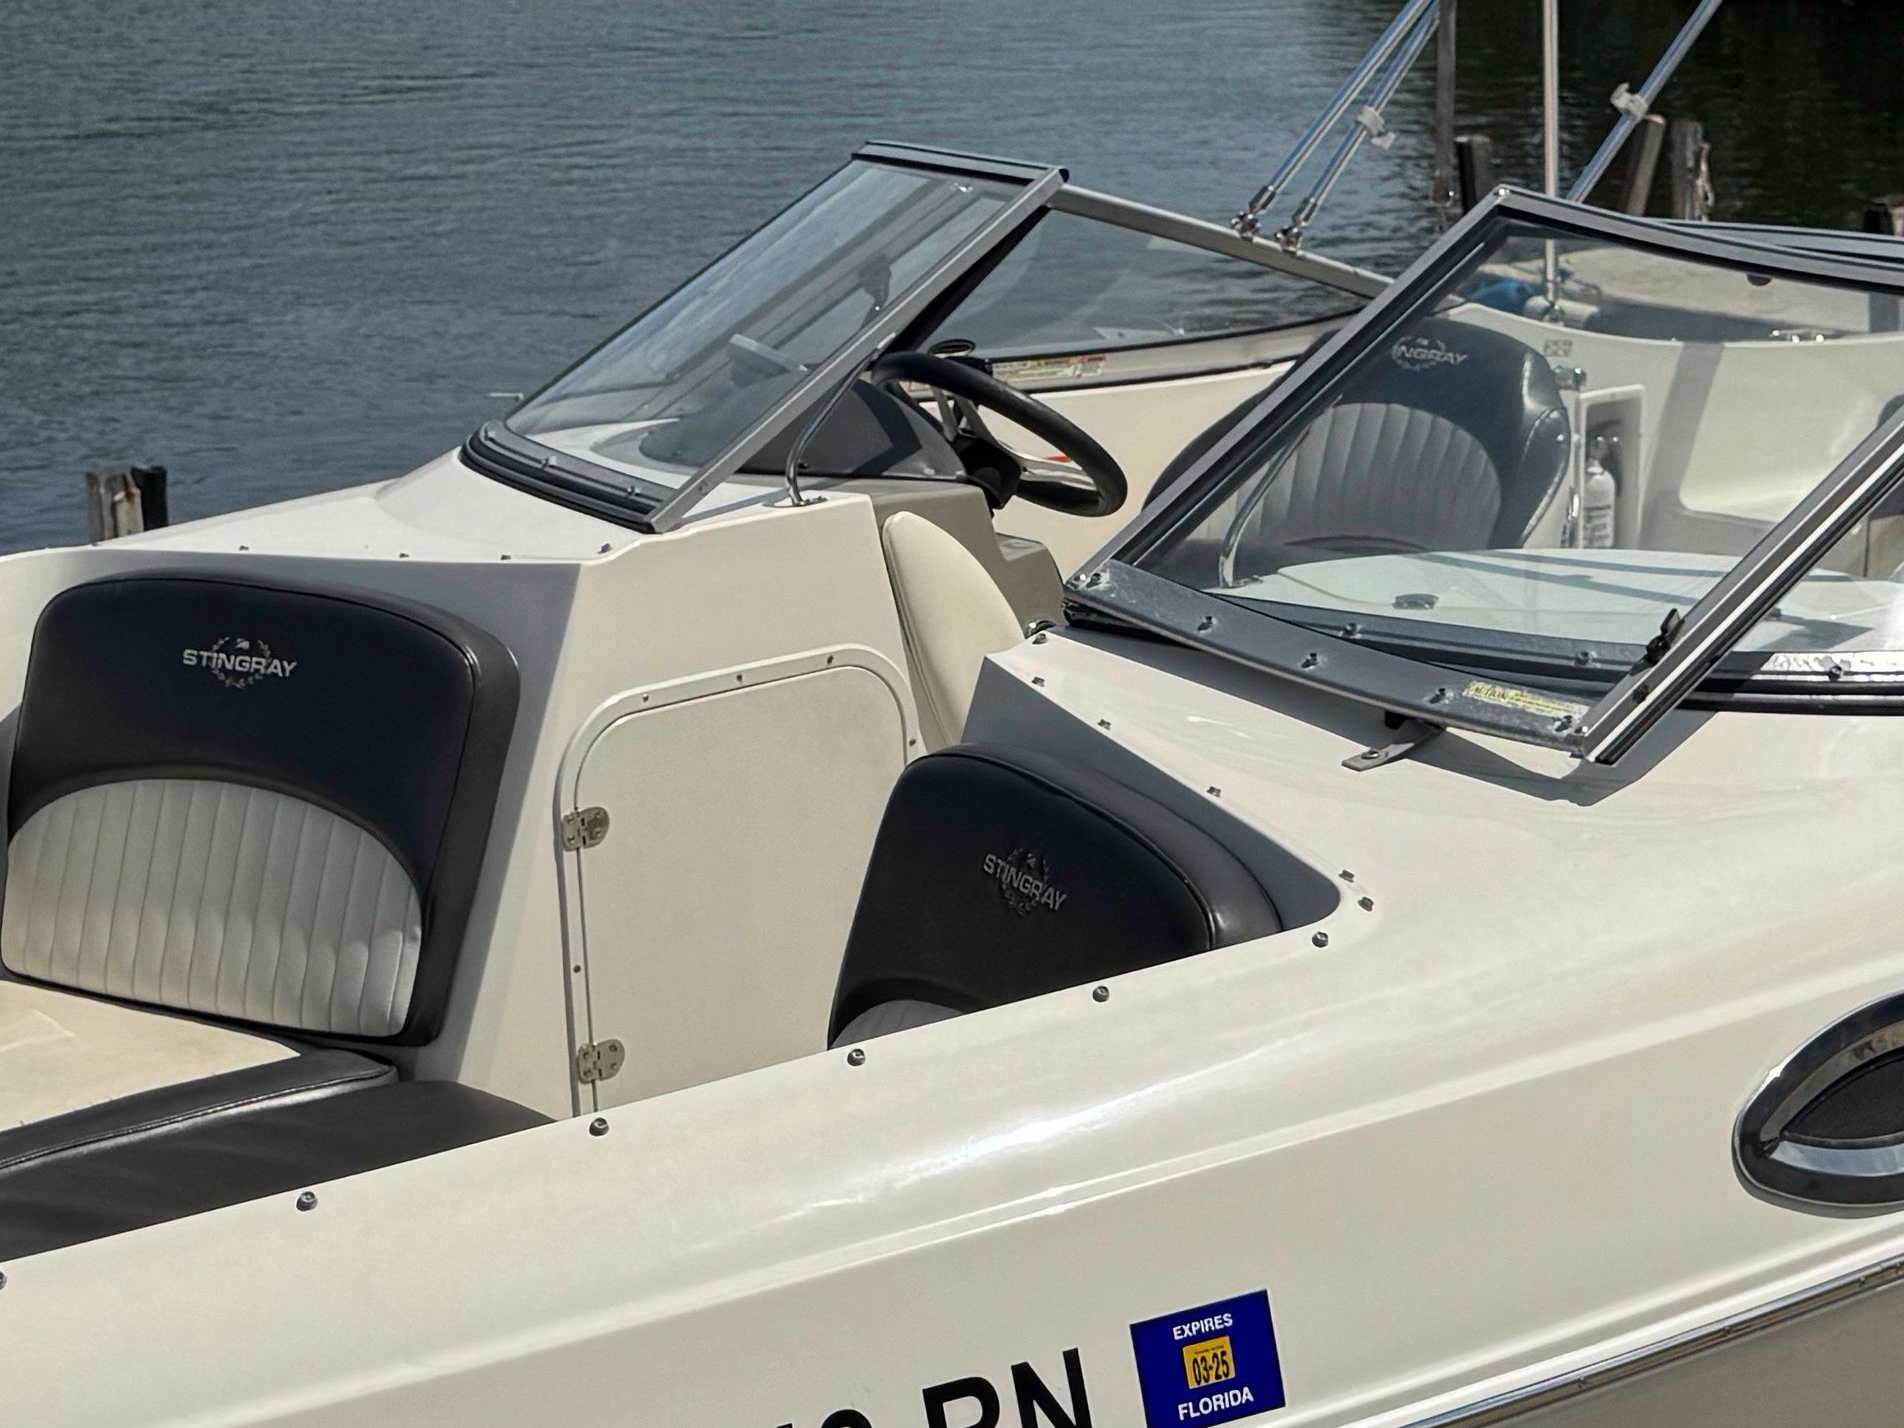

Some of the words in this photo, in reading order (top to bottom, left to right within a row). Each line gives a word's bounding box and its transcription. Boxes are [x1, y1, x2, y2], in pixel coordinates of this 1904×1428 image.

[1399, 344, 1468, 365] NGRAY
[183, 648, 297, 678] STINGRAY
[982, 853, 1068, 912] STINGRAY
[1172, 1313, 1233, 1340] EXPIRES
[1192, 1350, 1230, 1386] 03-25
[1177, 1386, 1254, 1421] FLORIDA
